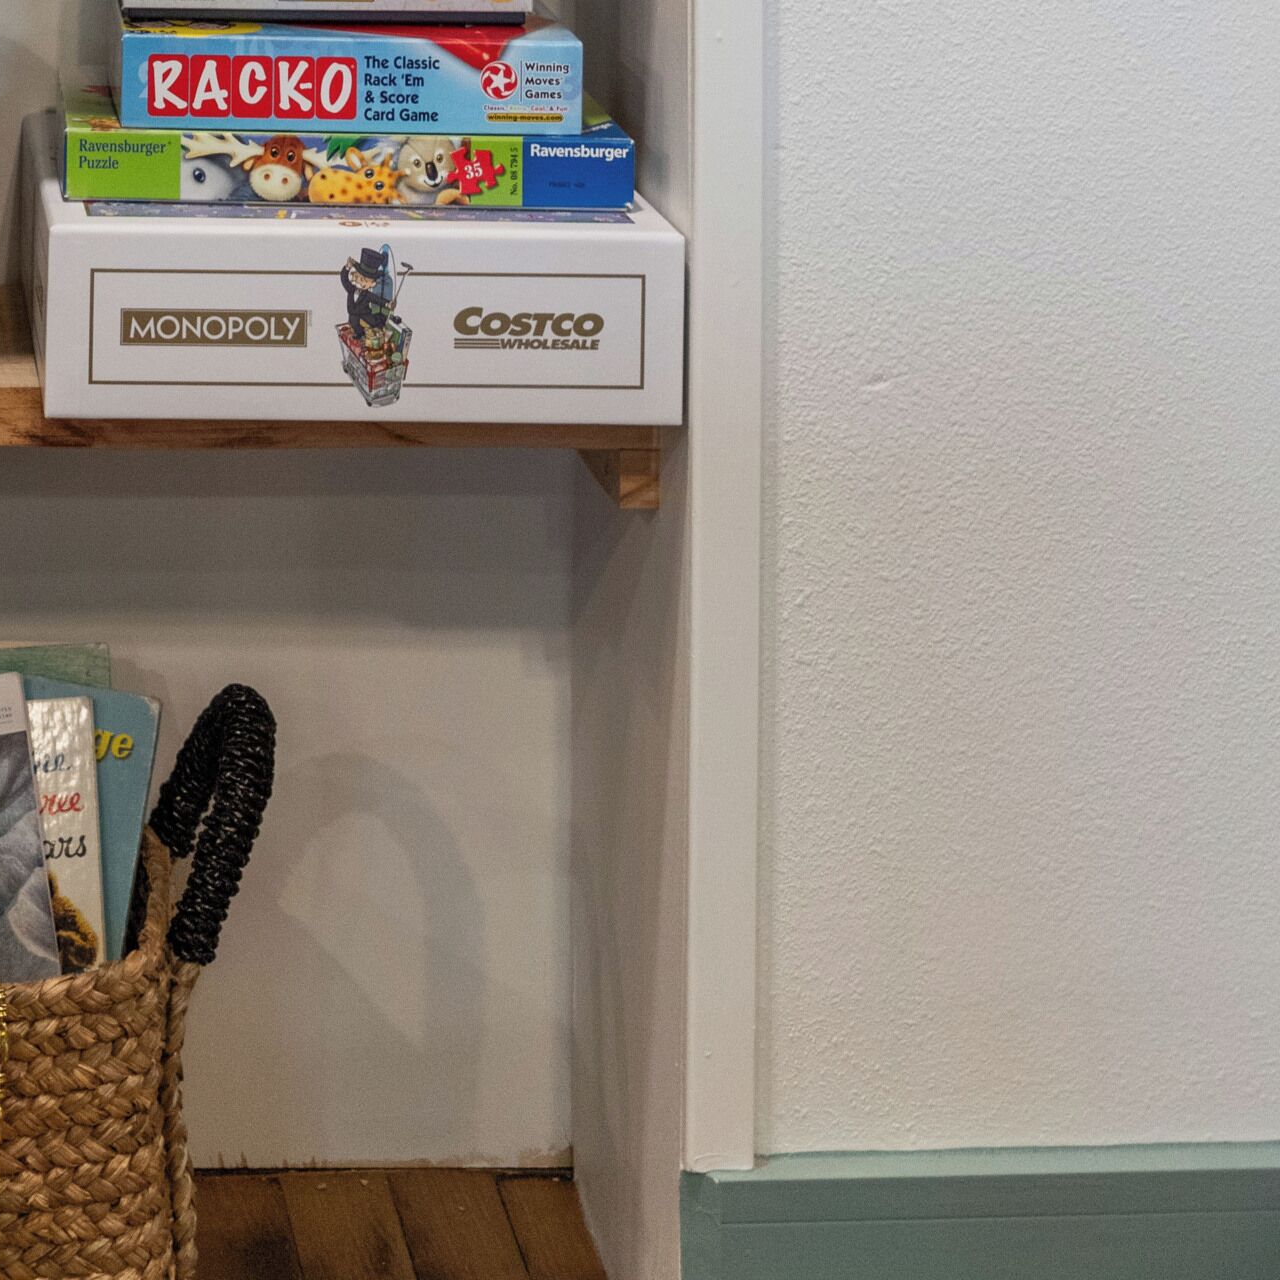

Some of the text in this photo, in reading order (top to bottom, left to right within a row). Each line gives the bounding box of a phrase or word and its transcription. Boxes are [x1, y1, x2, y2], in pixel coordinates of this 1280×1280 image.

[365, 56, 440, 70] The Classic
[525, 63, 569, 74] Winning
[364, 73, 397, 86] Rack
[525, 76, 560, 85] Moves
[364, 91, 419, 104] & Score
[525, 90, 562, 99] Games
[364, 108, 439, 122] Card Game
[79, 139, 167, 156] Ravensburger
[530, 143, 629, 161] Ravensburger
[79, 156, 119, 169] Puzzle
[464, 162, 483, 179] 35
[129, 315, 300, 340] MONOPOLY
[453, 306, 605, 337] COSTCO
[500, 339, 600, 350] WHOLESALE
